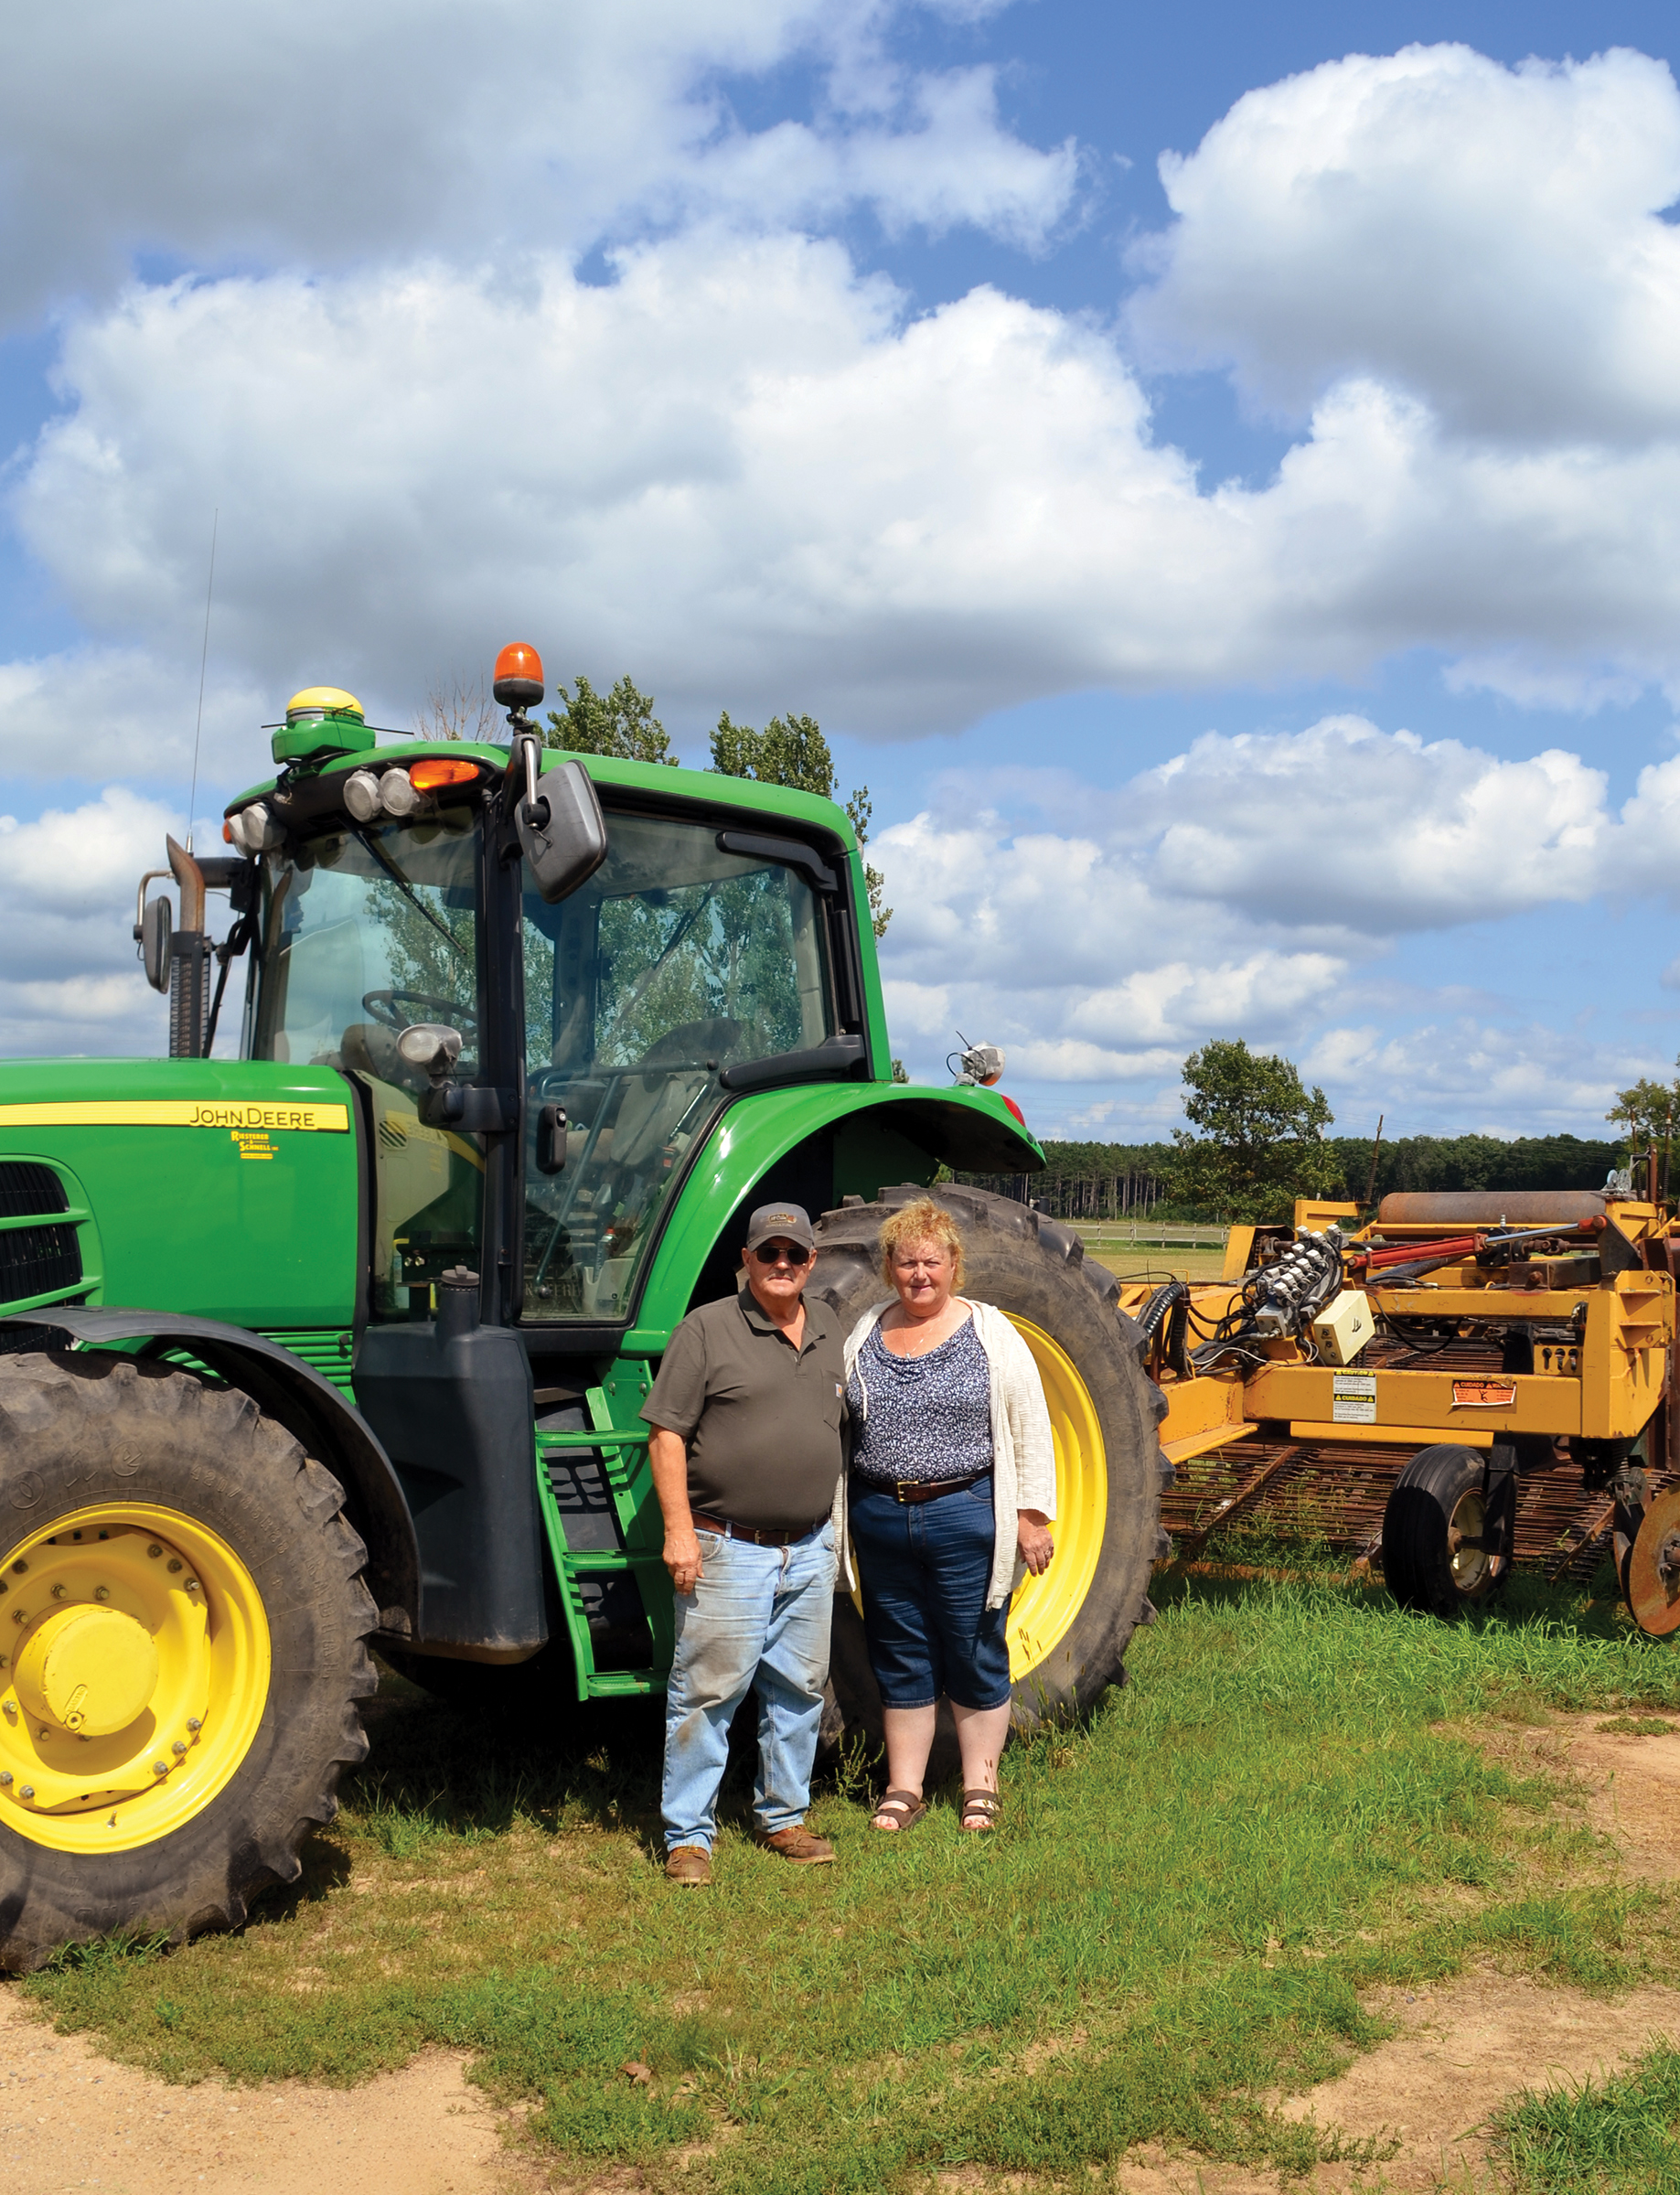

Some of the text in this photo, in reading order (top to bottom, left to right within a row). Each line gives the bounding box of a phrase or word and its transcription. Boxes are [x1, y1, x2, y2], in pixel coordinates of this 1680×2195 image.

[189, 1106, 316, 1127] JOHN DEERE
[230, 1130, 270, 1141] RIESTERER
[239, 1140, 271, 1151] SCHNELL
